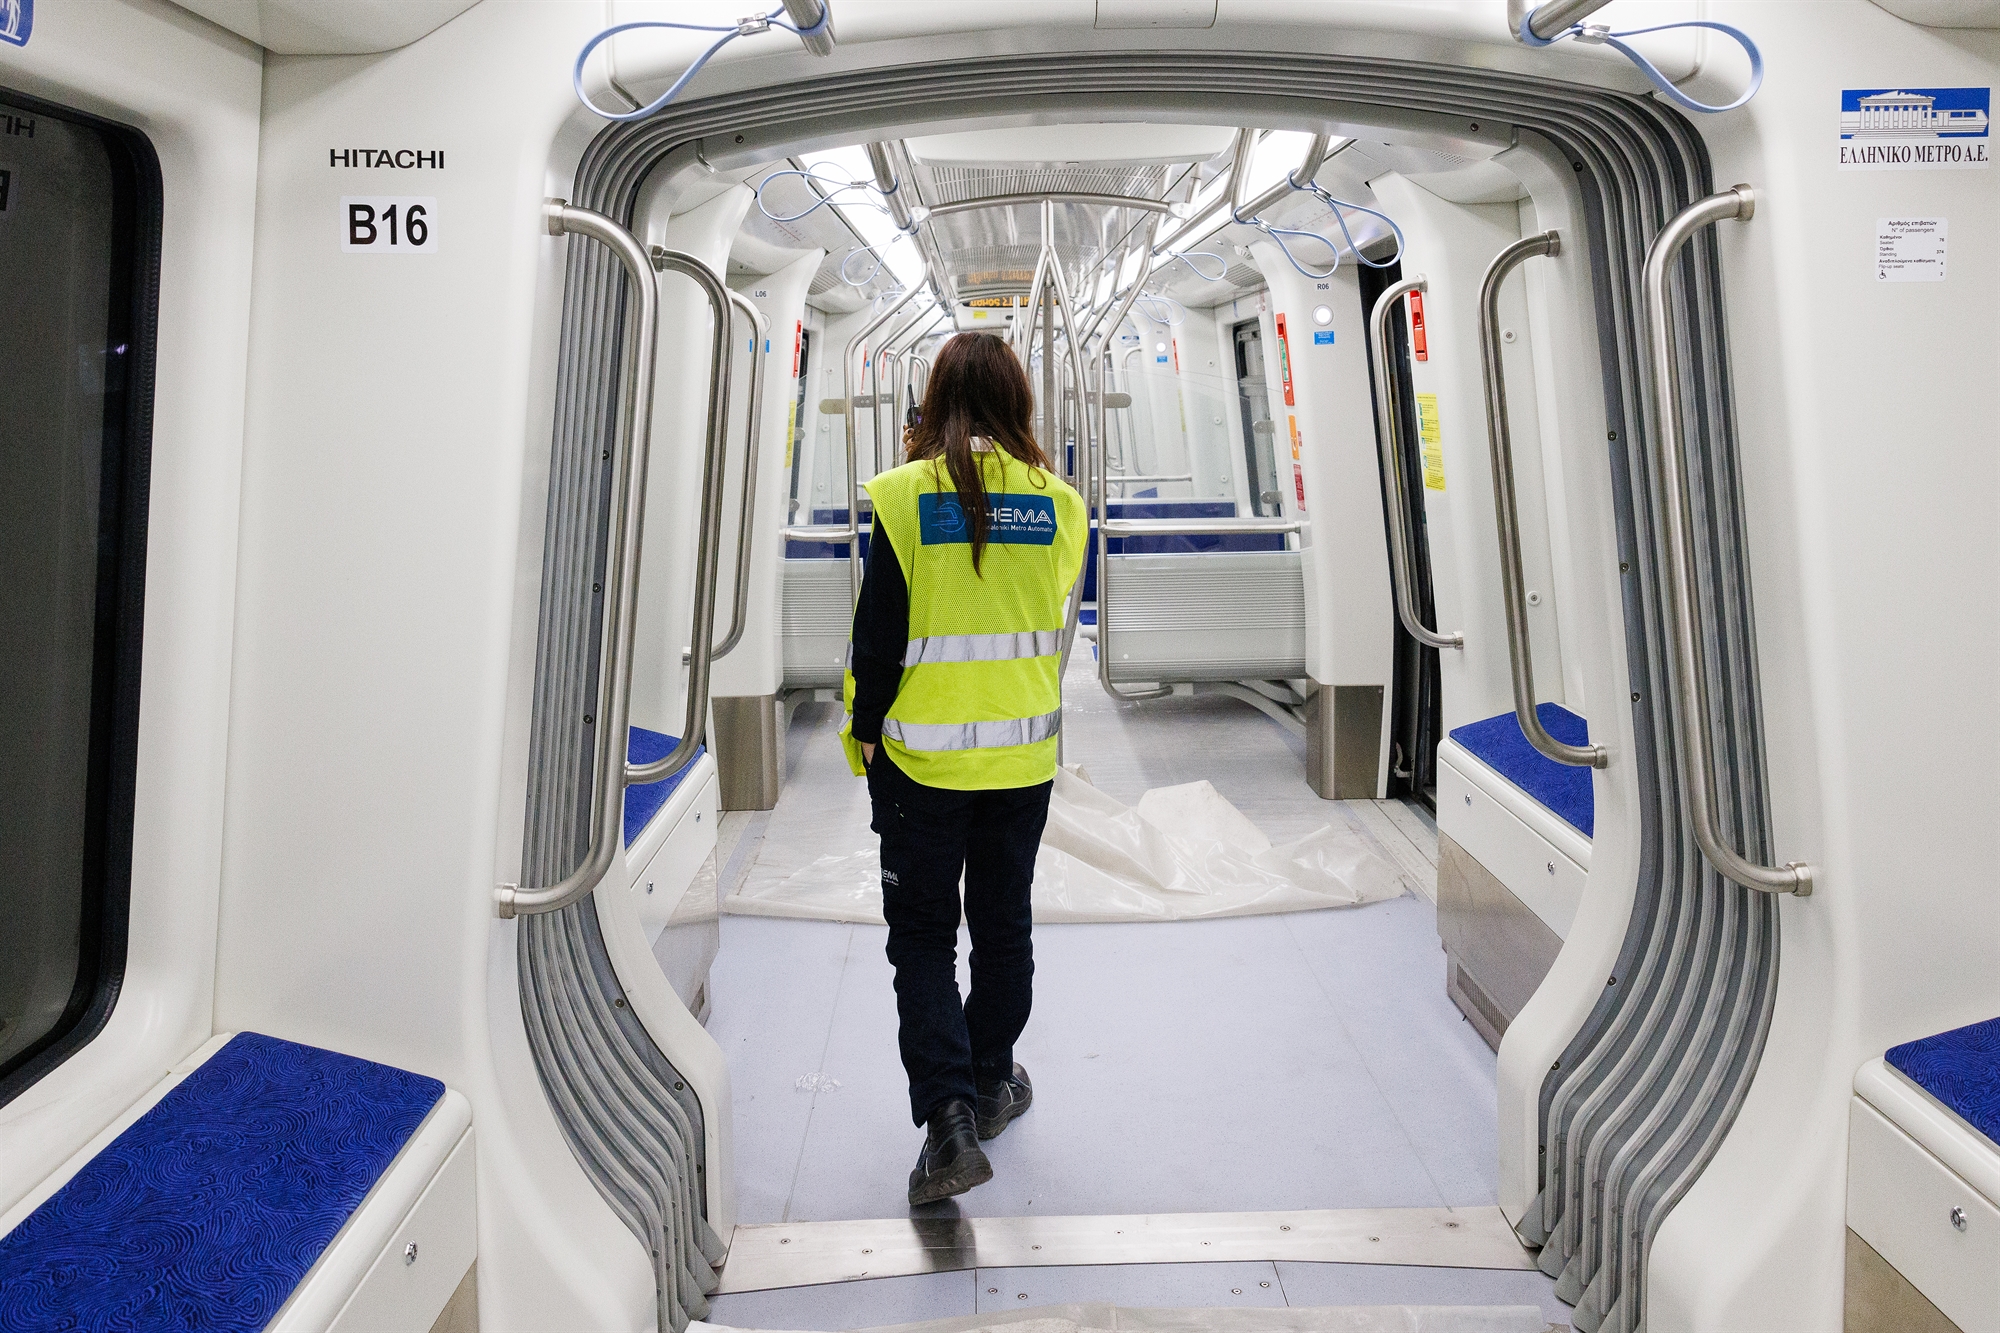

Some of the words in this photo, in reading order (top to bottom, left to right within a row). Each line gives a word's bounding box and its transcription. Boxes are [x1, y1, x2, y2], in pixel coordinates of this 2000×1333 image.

[330, 149, 444, 169] HITACHI
[1840, 146, 1911, 164] ΕΛΛΗΝΙΚΟ
[1914, 145, 1962, 163] ΜΕΤΡΟ
[1963, 145, 1988, 162] Α.Ε.
[349, 204, 428, 246] B16
[967, 507, 1053, 525] HEMA
[1010, 524, 1027, 532] Metro
[1027, 525, 1053, 533] Automatic
